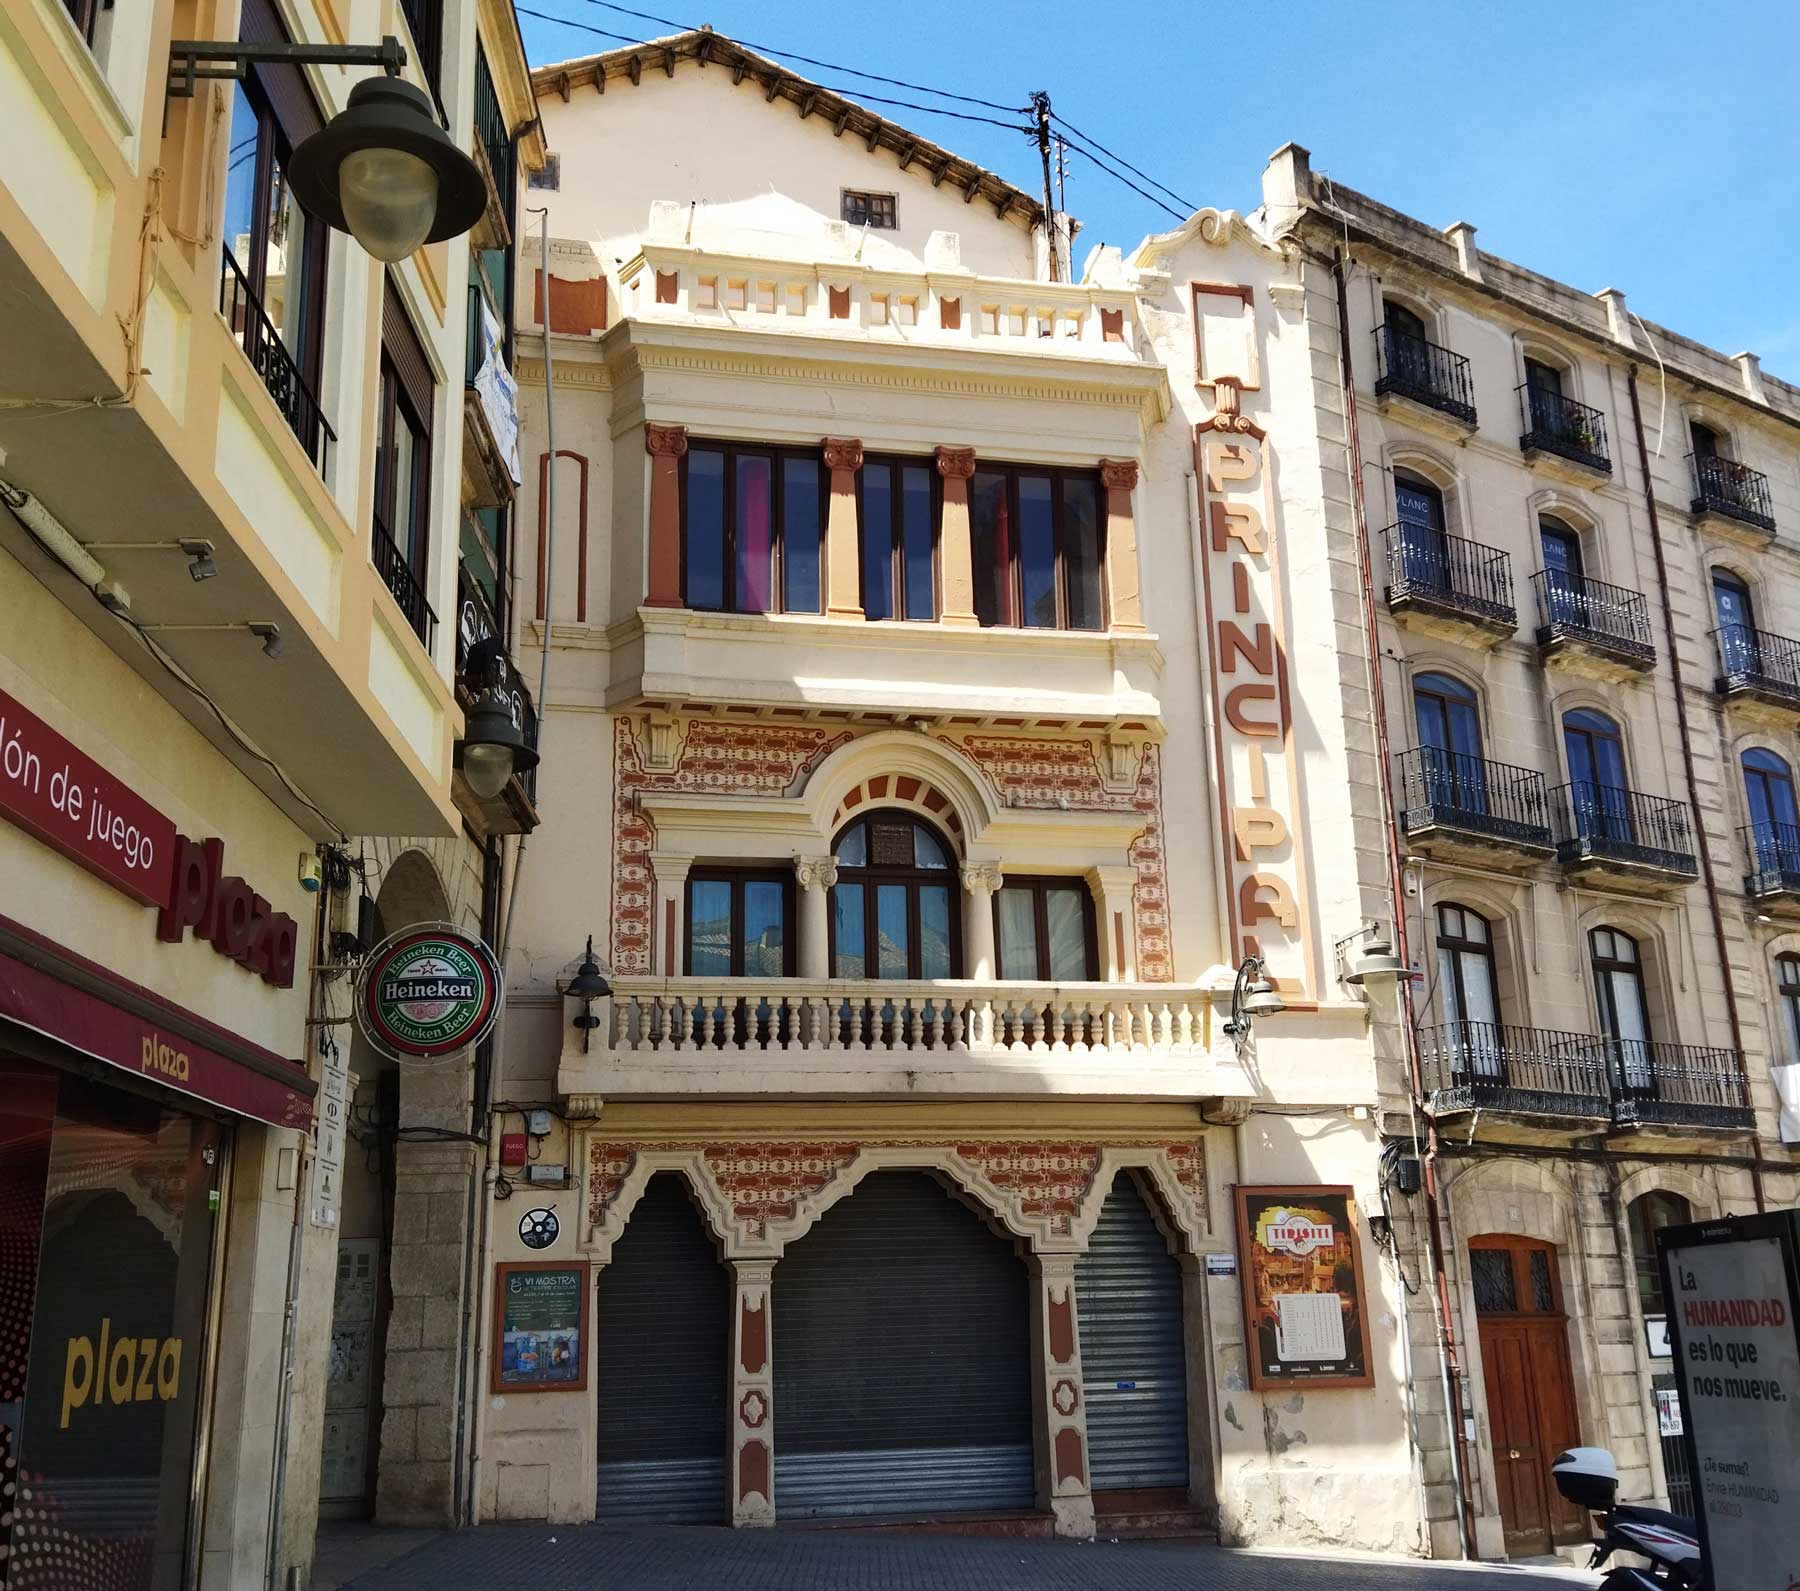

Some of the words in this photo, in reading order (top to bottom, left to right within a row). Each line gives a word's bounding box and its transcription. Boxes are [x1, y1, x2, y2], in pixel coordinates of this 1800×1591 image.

[1206, 441, 1304, 993] PRINCIPAL
[50, 765, 83, 821] de
[87, 787, 154, 870] juego
[159, 834, 298, 989] plaza
[389, 946, 445, 974] Heineken
[447, 949, 472, 973] Beer
[385, 980, 473, 1000] Heineken
[387, 1011, 442, 1039] Heineken
[444, 1008, 471, 1034] Beer
[141, 1033, 189, 1082] plaza
[535, 1276, 577, 1286] MOSTRA
[1678, 1265, 1697, 1291] La
[1683, 1299, 1787, 1328] HUMANIDAD
[1689, 1341, 1706, 1362] es
[1707, 1334, 1723, 1363] lo
[1726, 1342, 1758, 1369] que
[60, 1318, 182, 1429] plaza
[1693, 1375, 1723, 1398] nos
[1725, 1376, 1787, 1402] mueve.
[1718, 1461, 1750, 1477] sumas?
